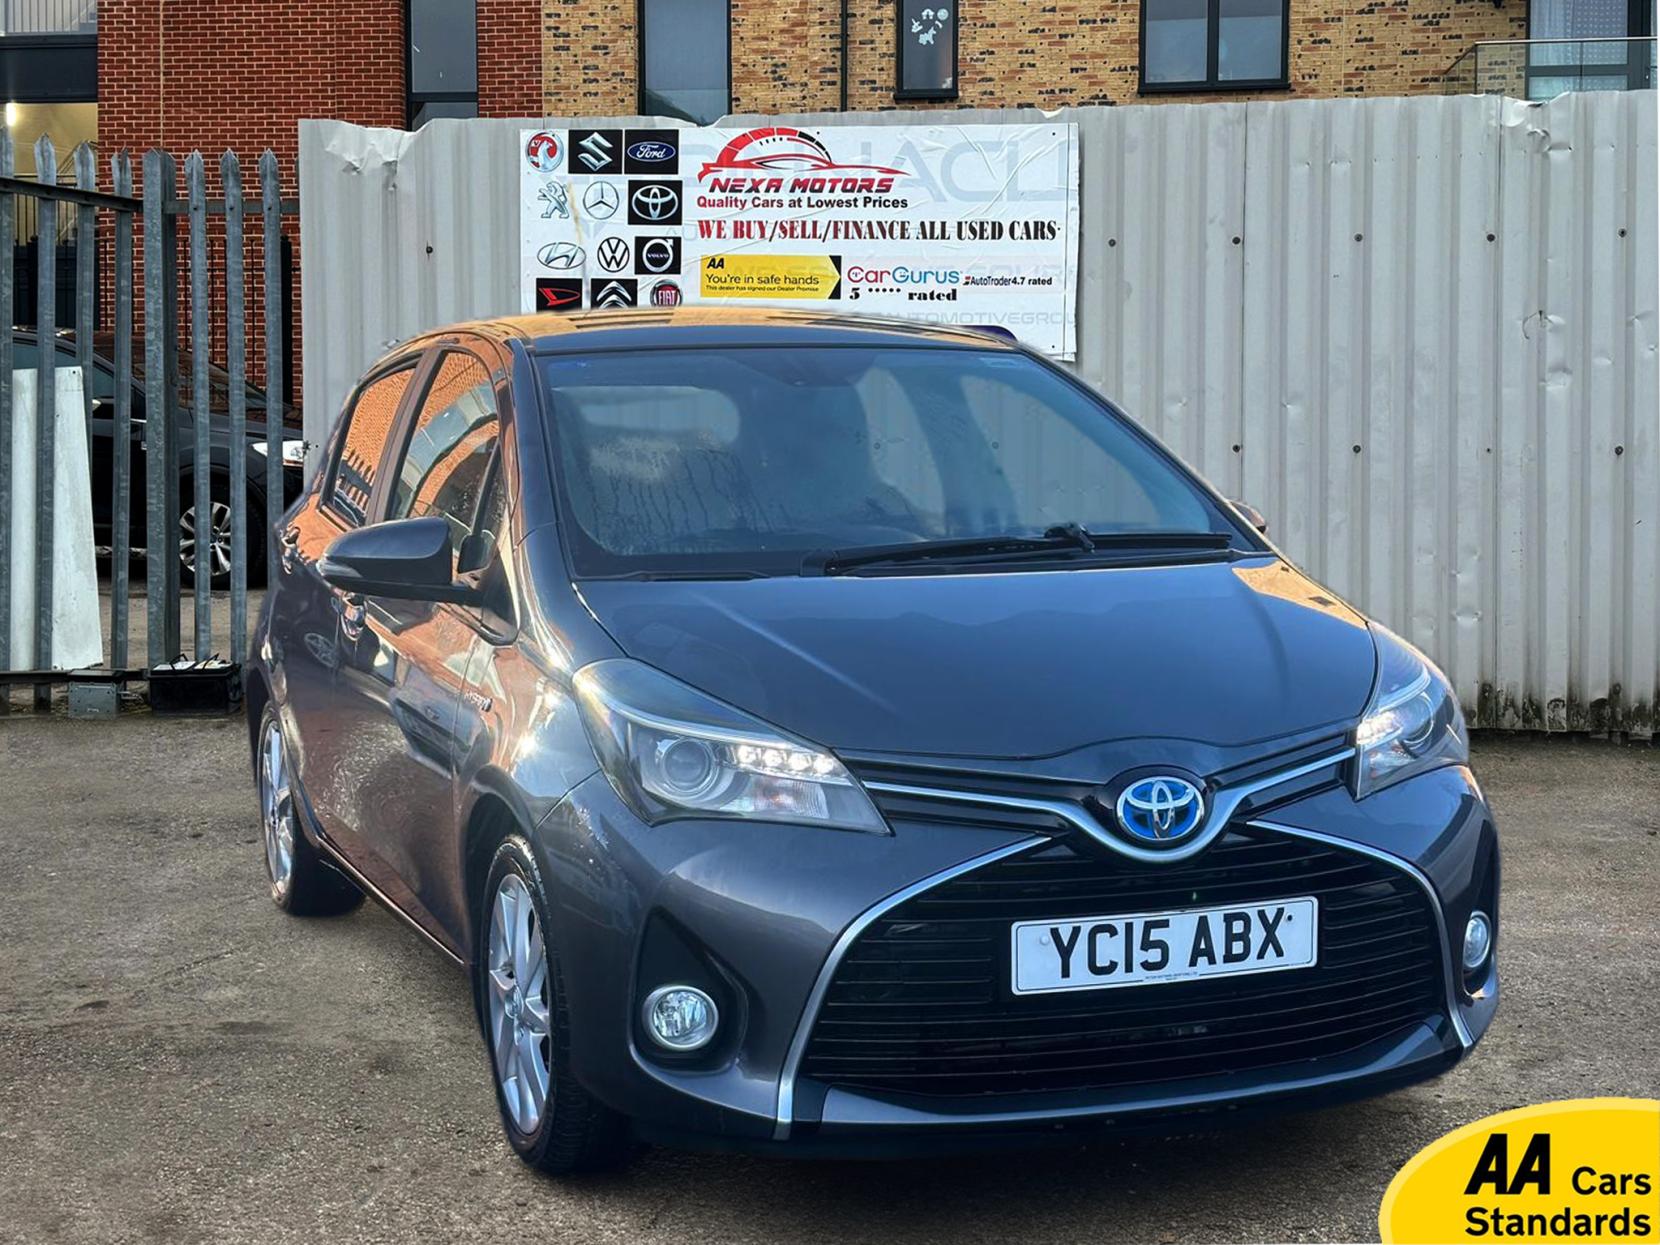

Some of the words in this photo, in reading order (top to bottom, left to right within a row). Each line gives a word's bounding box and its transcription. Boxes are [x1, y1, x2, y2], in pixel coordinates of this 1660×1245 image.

[635, 143, 667, 160] Ford
[709, 177, 783, 194] NEXA
[789, 177, 894, 194] MOTORS
[697, 196, 746, 211] Quality
[752, 196, 784, 208] Cars
[788, 197, 803, 208] at
[807, 196, 859, 208] Lowest
[863, 196, 908, 208] Prices
[697, 219, 727, 240] WE
[916, 220, 951, 241] ALL
[956, 220, 1004, 241] USED
[1008, 220, 1057, 241] CARS
[706, 257, 725, 269] AA
[705, 273, 741, 284] You're
[744, 274, 754, 284] in
[757, 274, 781, 285] safe
[784, 275, 820, 285] hands
[847, 265, 961, 284] CarGurus
[1027, 276, 1053, 286] rated
[658, 290, 676, 306] FIAT
[849, 287, 861, 300] 5
[908, 288, 958, 301] rated
[1050, 919, 1170, 979] YC15
[1188, 907, 1285, 968] ABX
